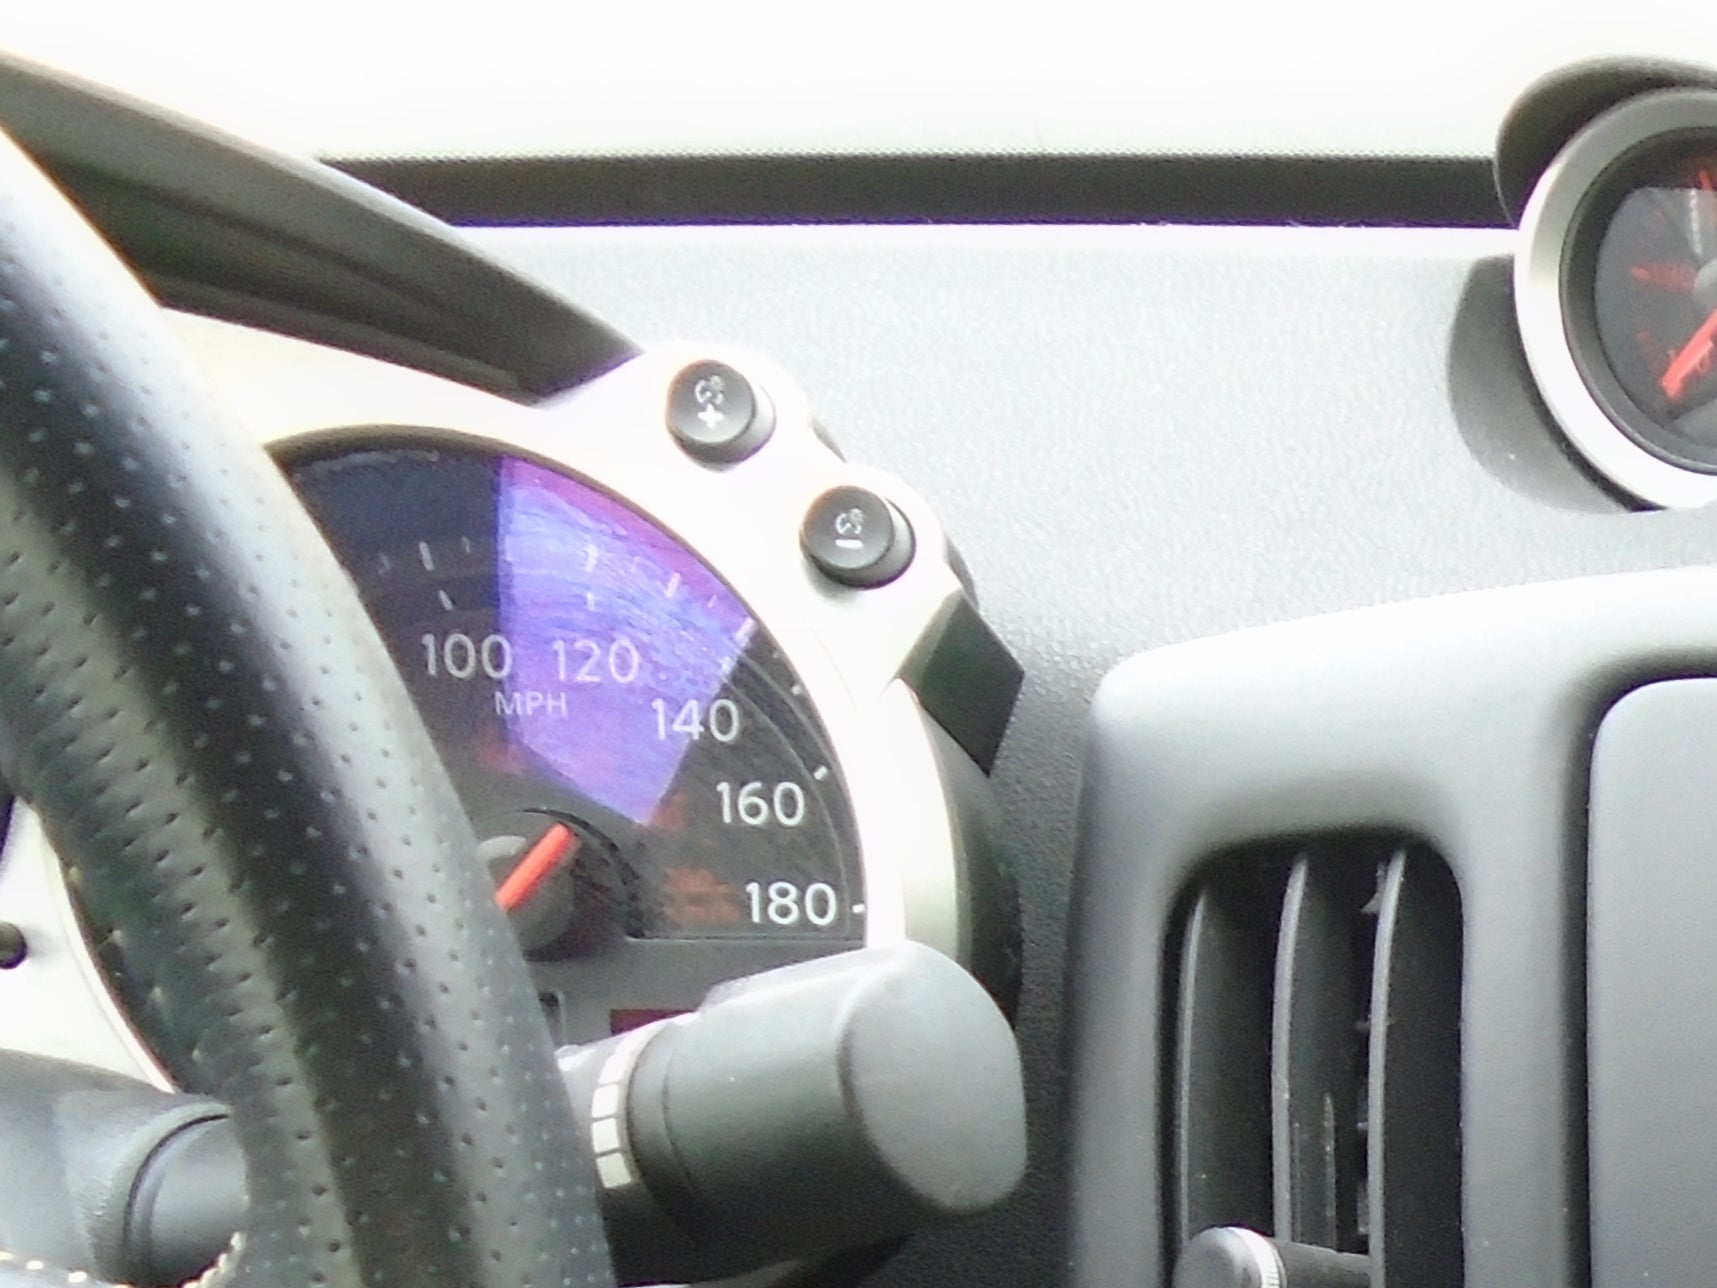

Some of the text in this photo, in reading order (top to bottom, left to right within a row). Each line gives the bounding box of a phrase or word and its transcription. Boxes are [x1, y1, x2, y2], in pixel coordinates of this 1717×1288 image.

[421, 633, 513, 679] 100
[552, 638, 640, 683] 120
[494, 690, 568, 717] MPH
[651, 697, 741, 743] 140
[716, 781, 806, 827] 160
[745, 881, 837, 927] 180
